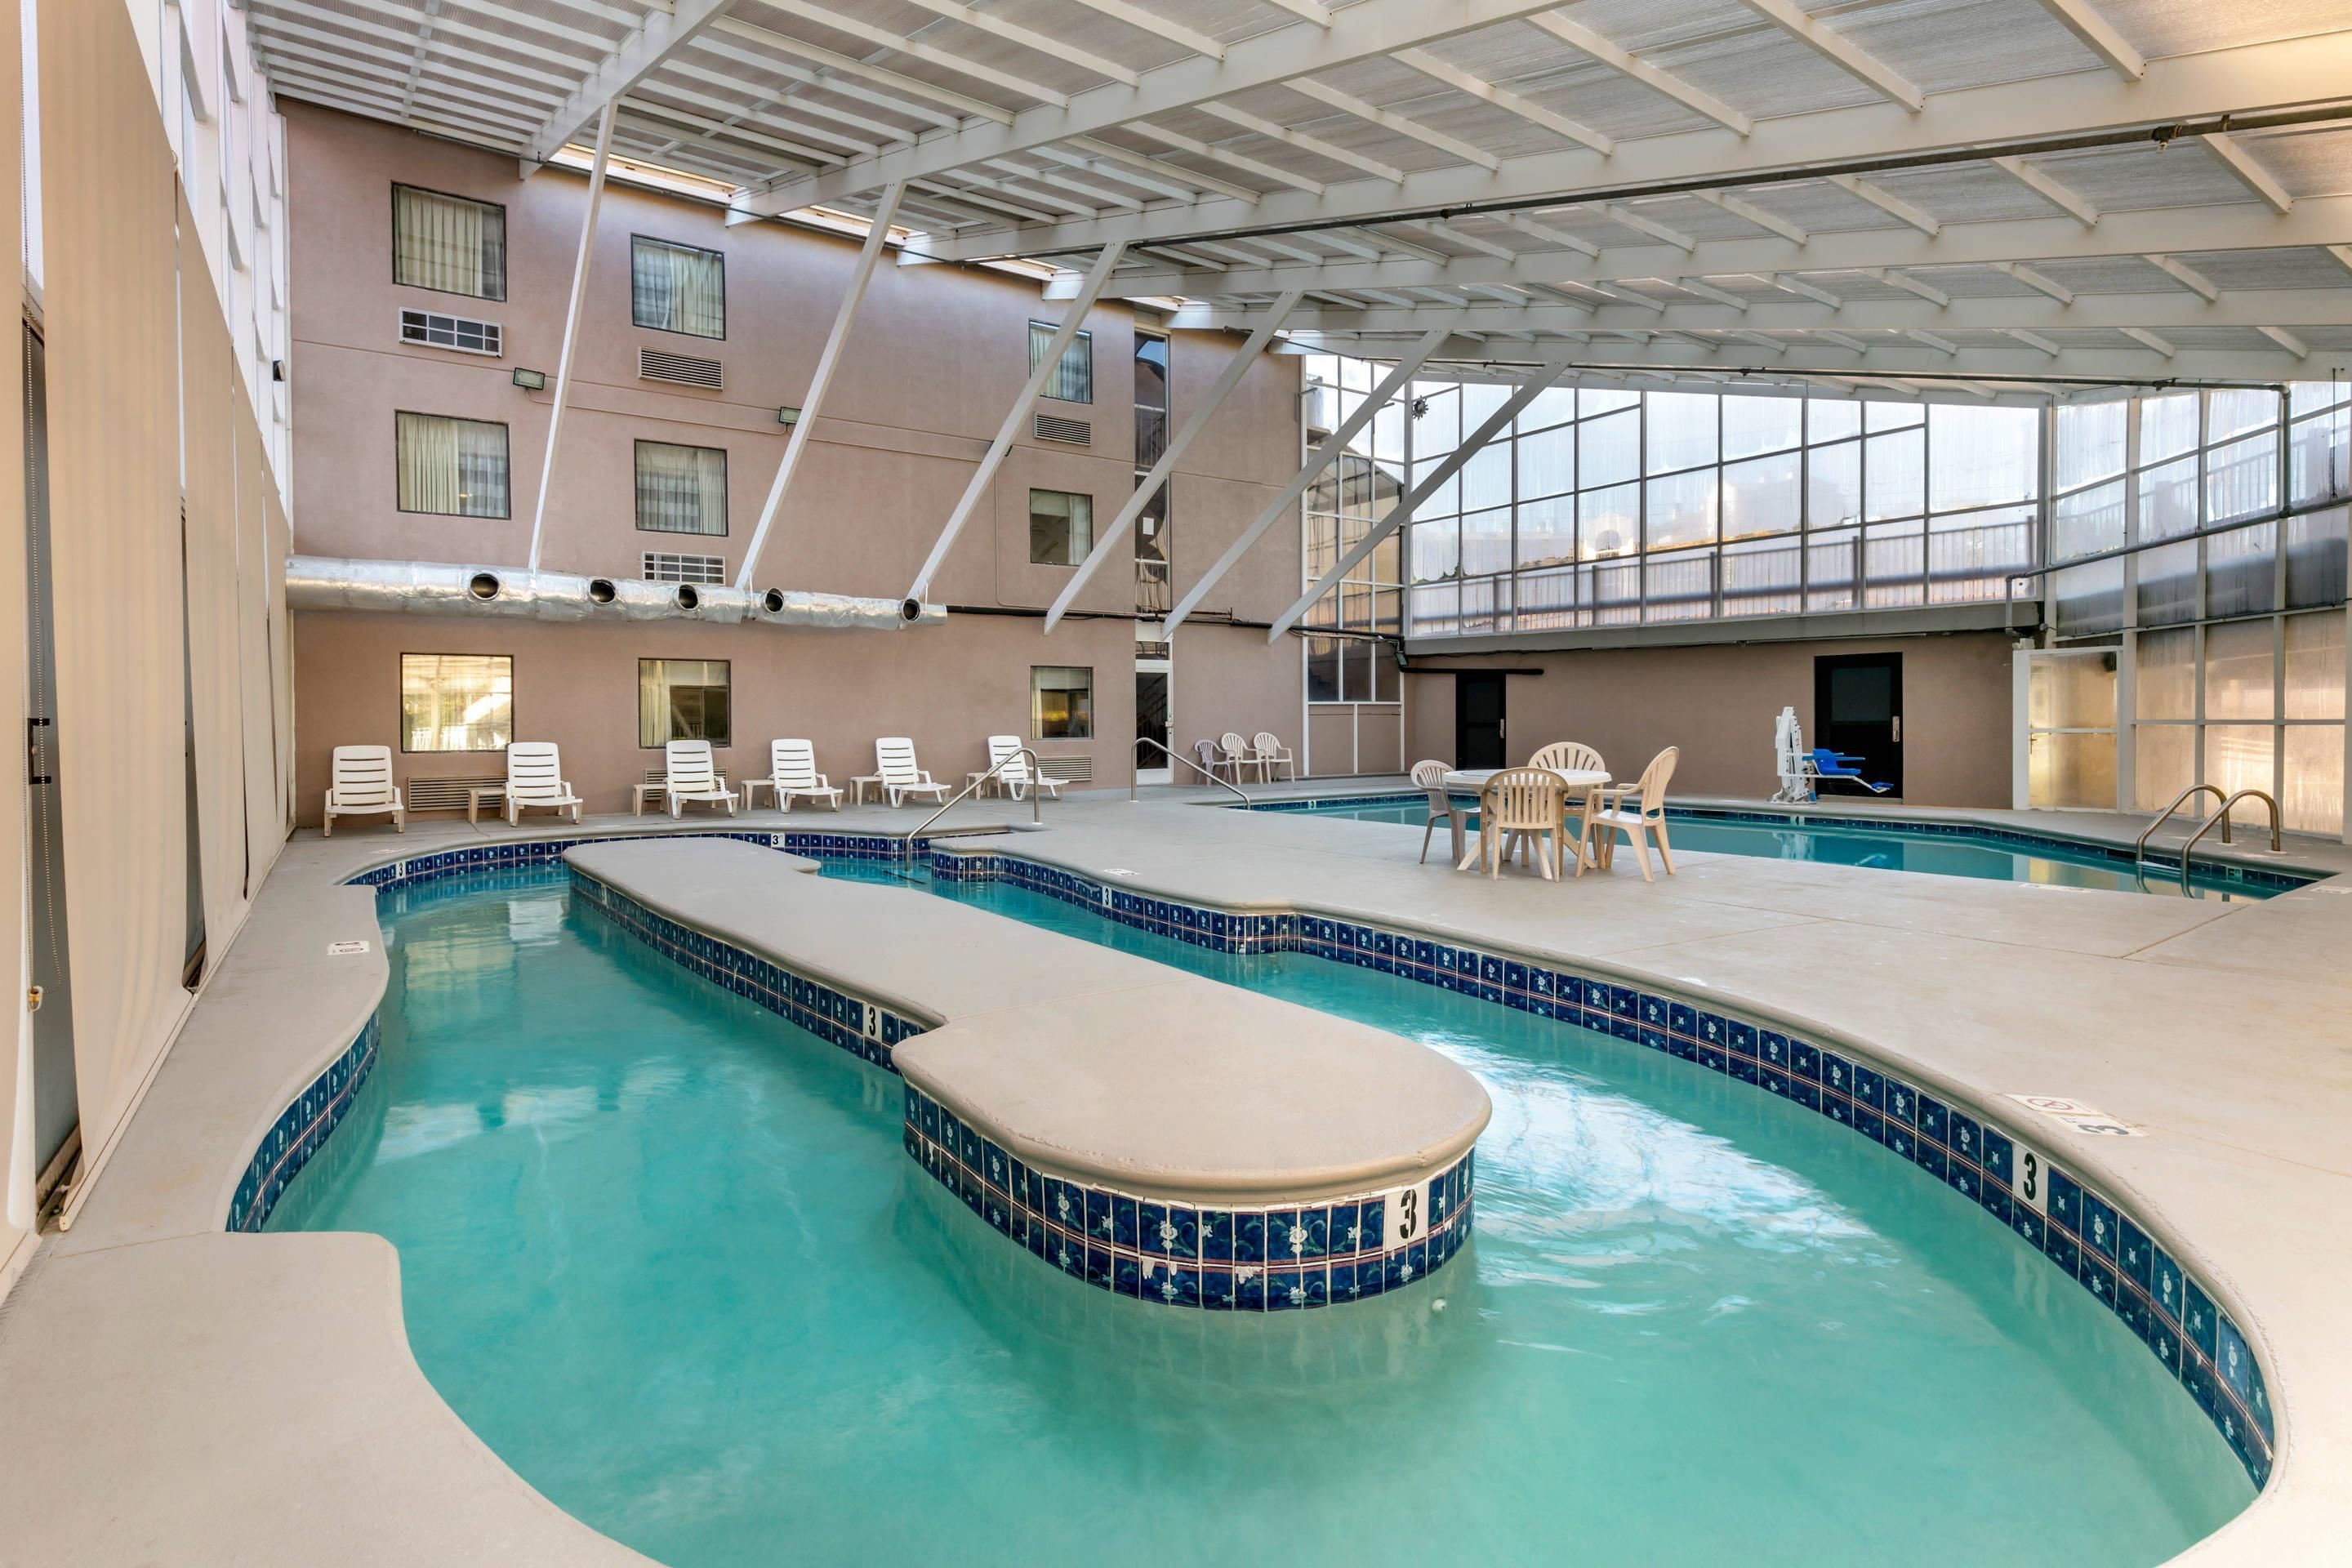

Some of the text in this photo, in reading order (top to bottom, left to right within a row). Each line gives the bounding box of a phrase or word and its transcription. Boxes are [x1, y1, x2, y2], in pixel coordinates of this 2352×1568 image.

[773, 835, 779, 845] 3
[399, 862, 403, 876] 3
[1105, 888, 1109, 906] 3
[869, 1006, 876, 1036] 3
[2024, 1152, 2037, 1200] 3
[1399, 1189, 1417, 1240] 3
